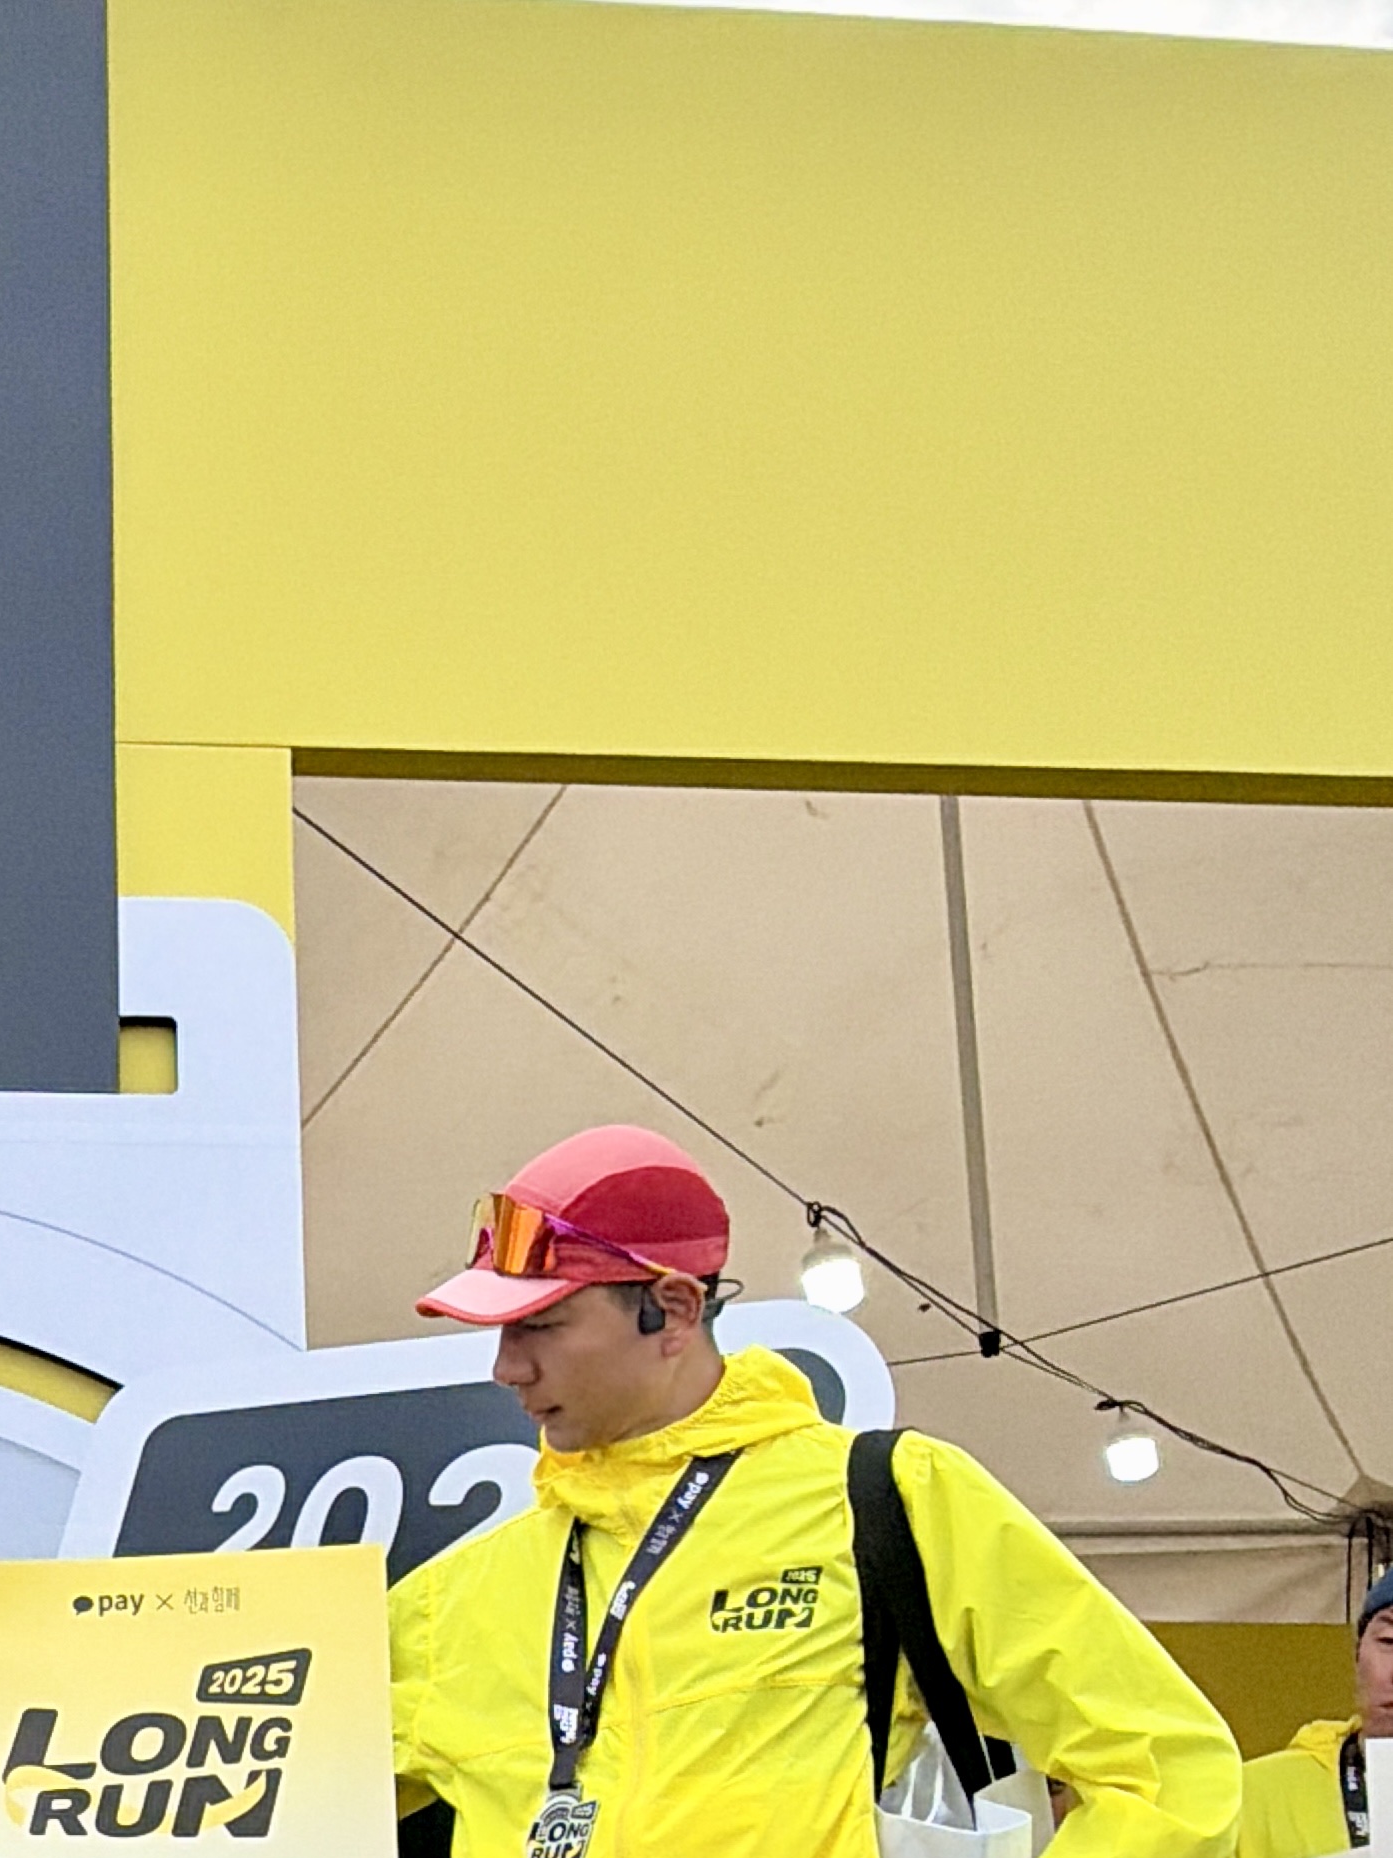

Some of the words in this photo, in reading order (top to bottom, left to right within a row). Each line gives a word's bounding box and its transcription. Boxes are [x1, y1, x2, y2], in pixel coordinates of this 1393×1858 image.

[210, 1442, 542, 1568] 202
[97, 1593, 145, 1617] pay
[710, 1586, 819, 1618] LONG
[720, 1606, 815, 1634] RUN
[207, 1659, 298, 1695] 2025
[1, 1707, 294, 1786] LONG
[28, 1767, 283, 1838] RUN
[526, 1821, 590, 1846] LONG
